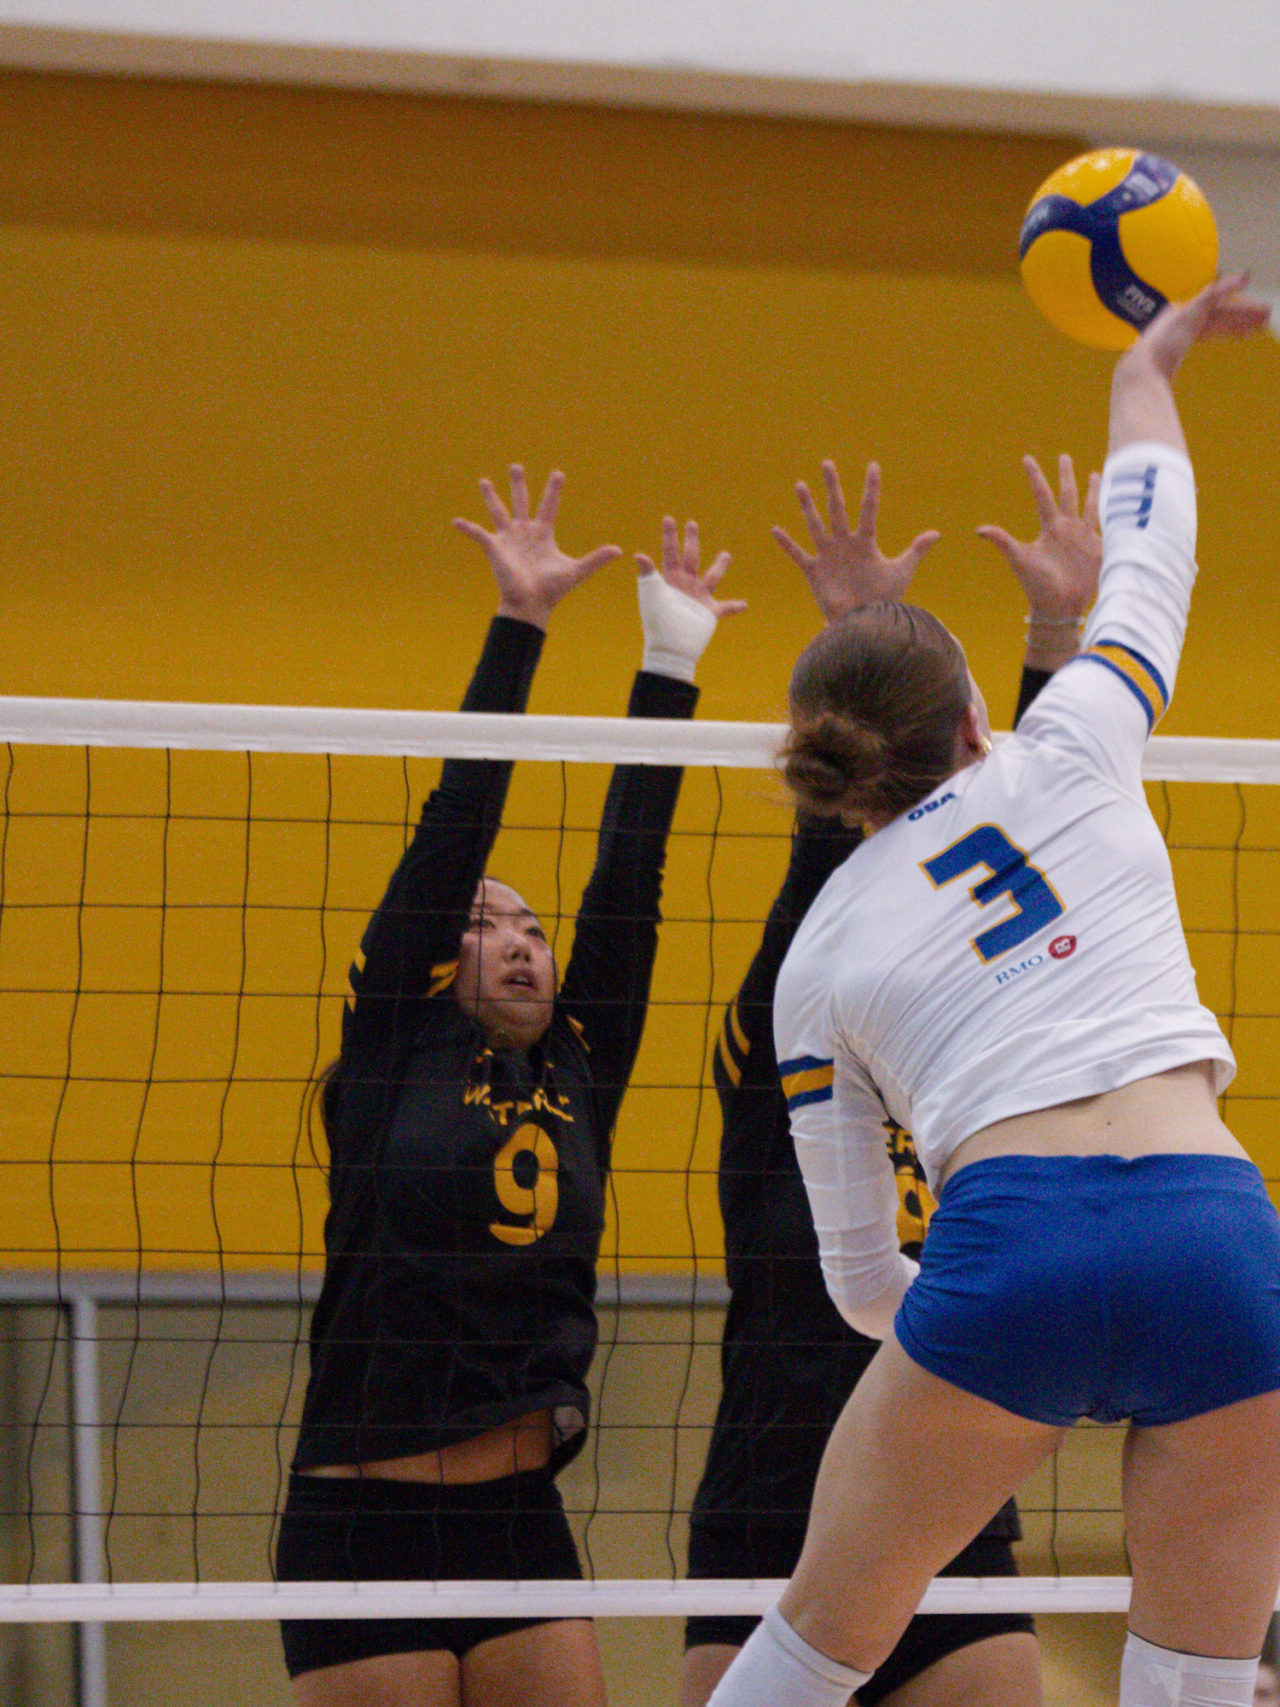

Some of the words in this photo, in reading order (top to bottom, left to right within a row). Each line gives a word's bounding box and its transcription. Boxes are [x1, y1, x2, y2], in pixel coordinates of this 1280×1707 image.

[918, 822, 1067, 965] 3
[994, 954, 1044, 985] BMO
[489, 1123, 559, 1246] 9
